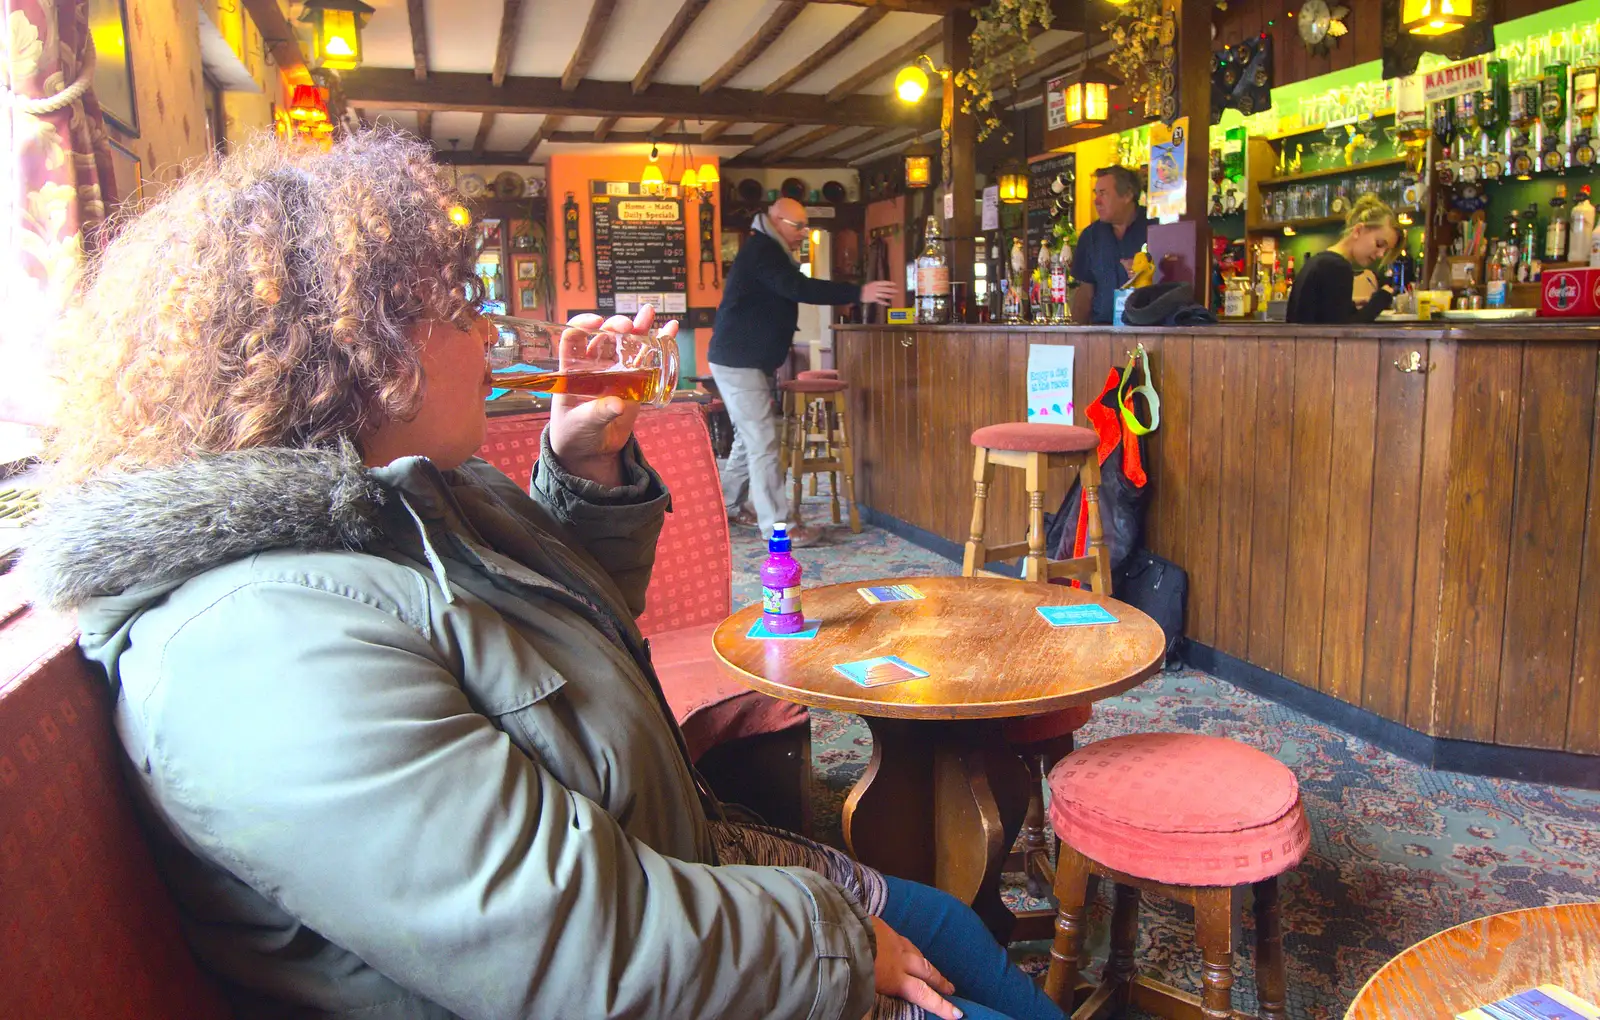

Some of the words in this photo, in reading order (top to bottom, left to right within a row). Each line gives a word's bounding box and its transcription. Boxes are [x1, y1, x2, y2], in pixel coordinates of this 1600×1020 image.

[1425, 60, 1483, 89] MARTINI
[623, 211, 642, 220] Daily
[646, 211, 675, 220] Specials
[1030, 371, 1049, 382] Enjoy
[1051, 378, 1068, 389] races
